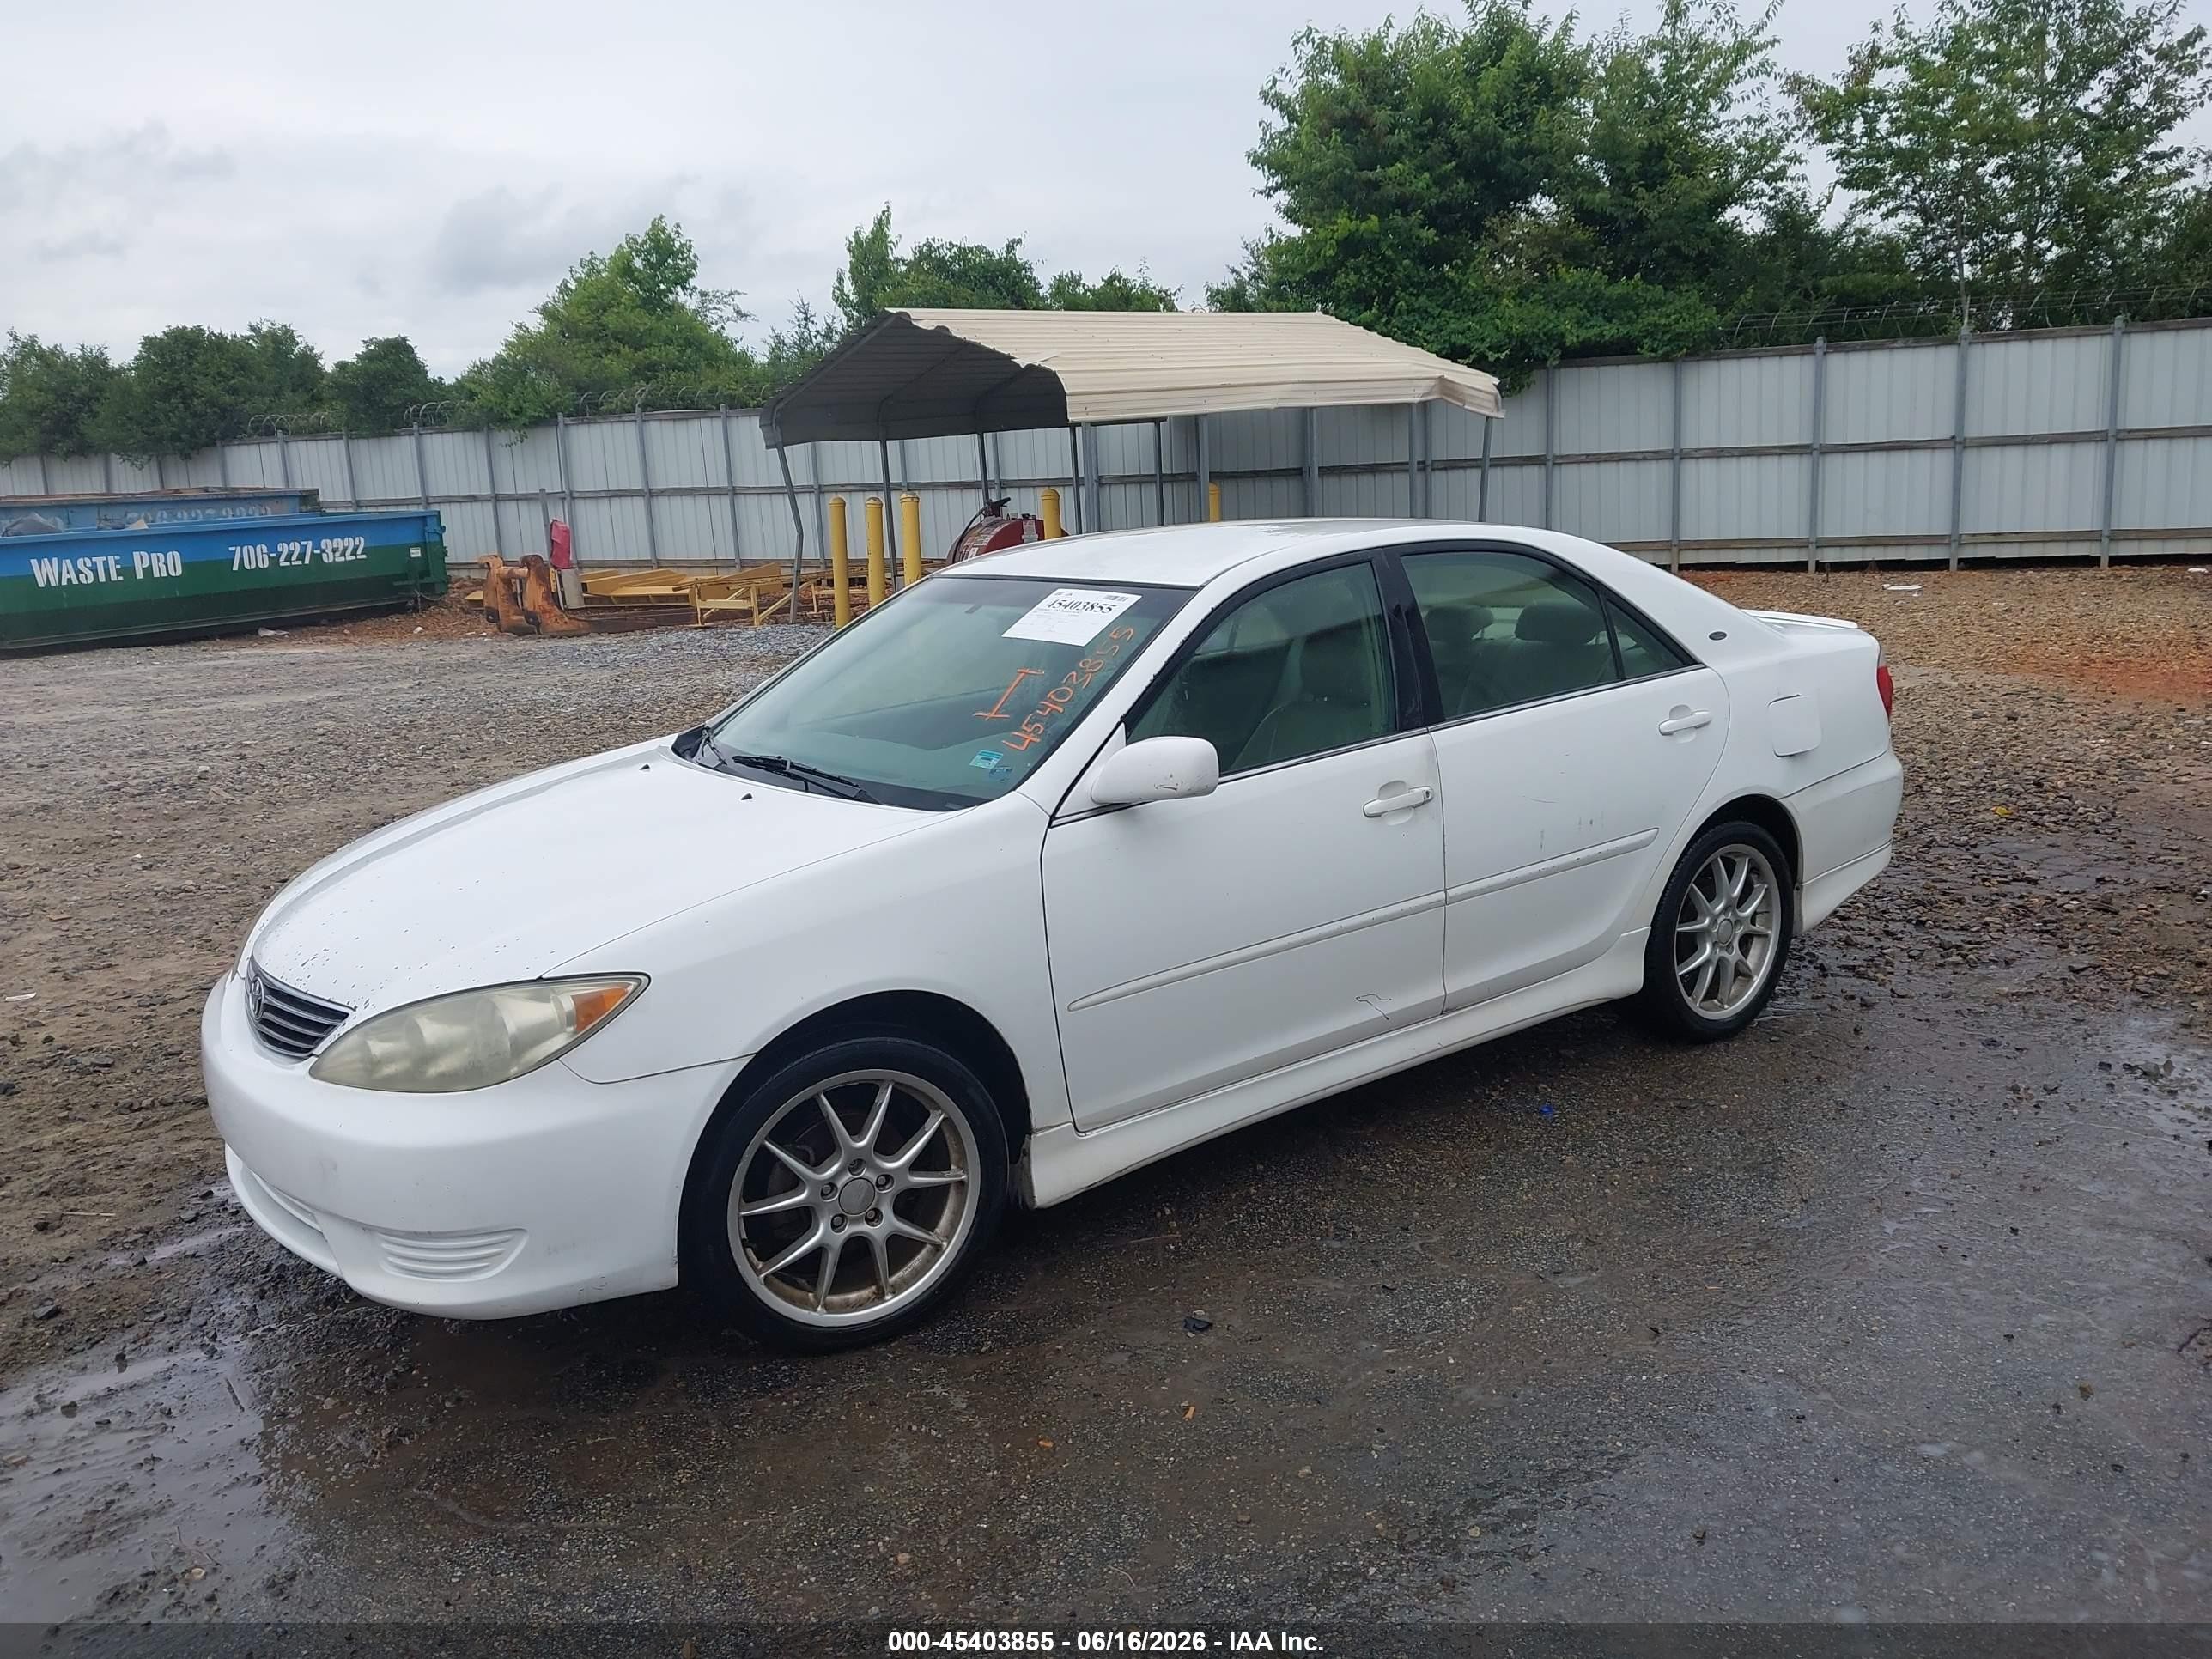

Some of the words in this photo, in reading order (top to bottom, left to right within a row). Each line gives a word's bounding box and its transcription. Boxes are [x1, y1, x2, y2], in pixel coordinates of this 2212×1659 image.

[31, 556, 123, 588] WASTE
[133, 550, 183, 580] PRO
[228, 536, 368, 571] 706-227-3222
[1046, 599, 1117, 614] 45403855
[1002, 626, 1134, 751] 45403855
